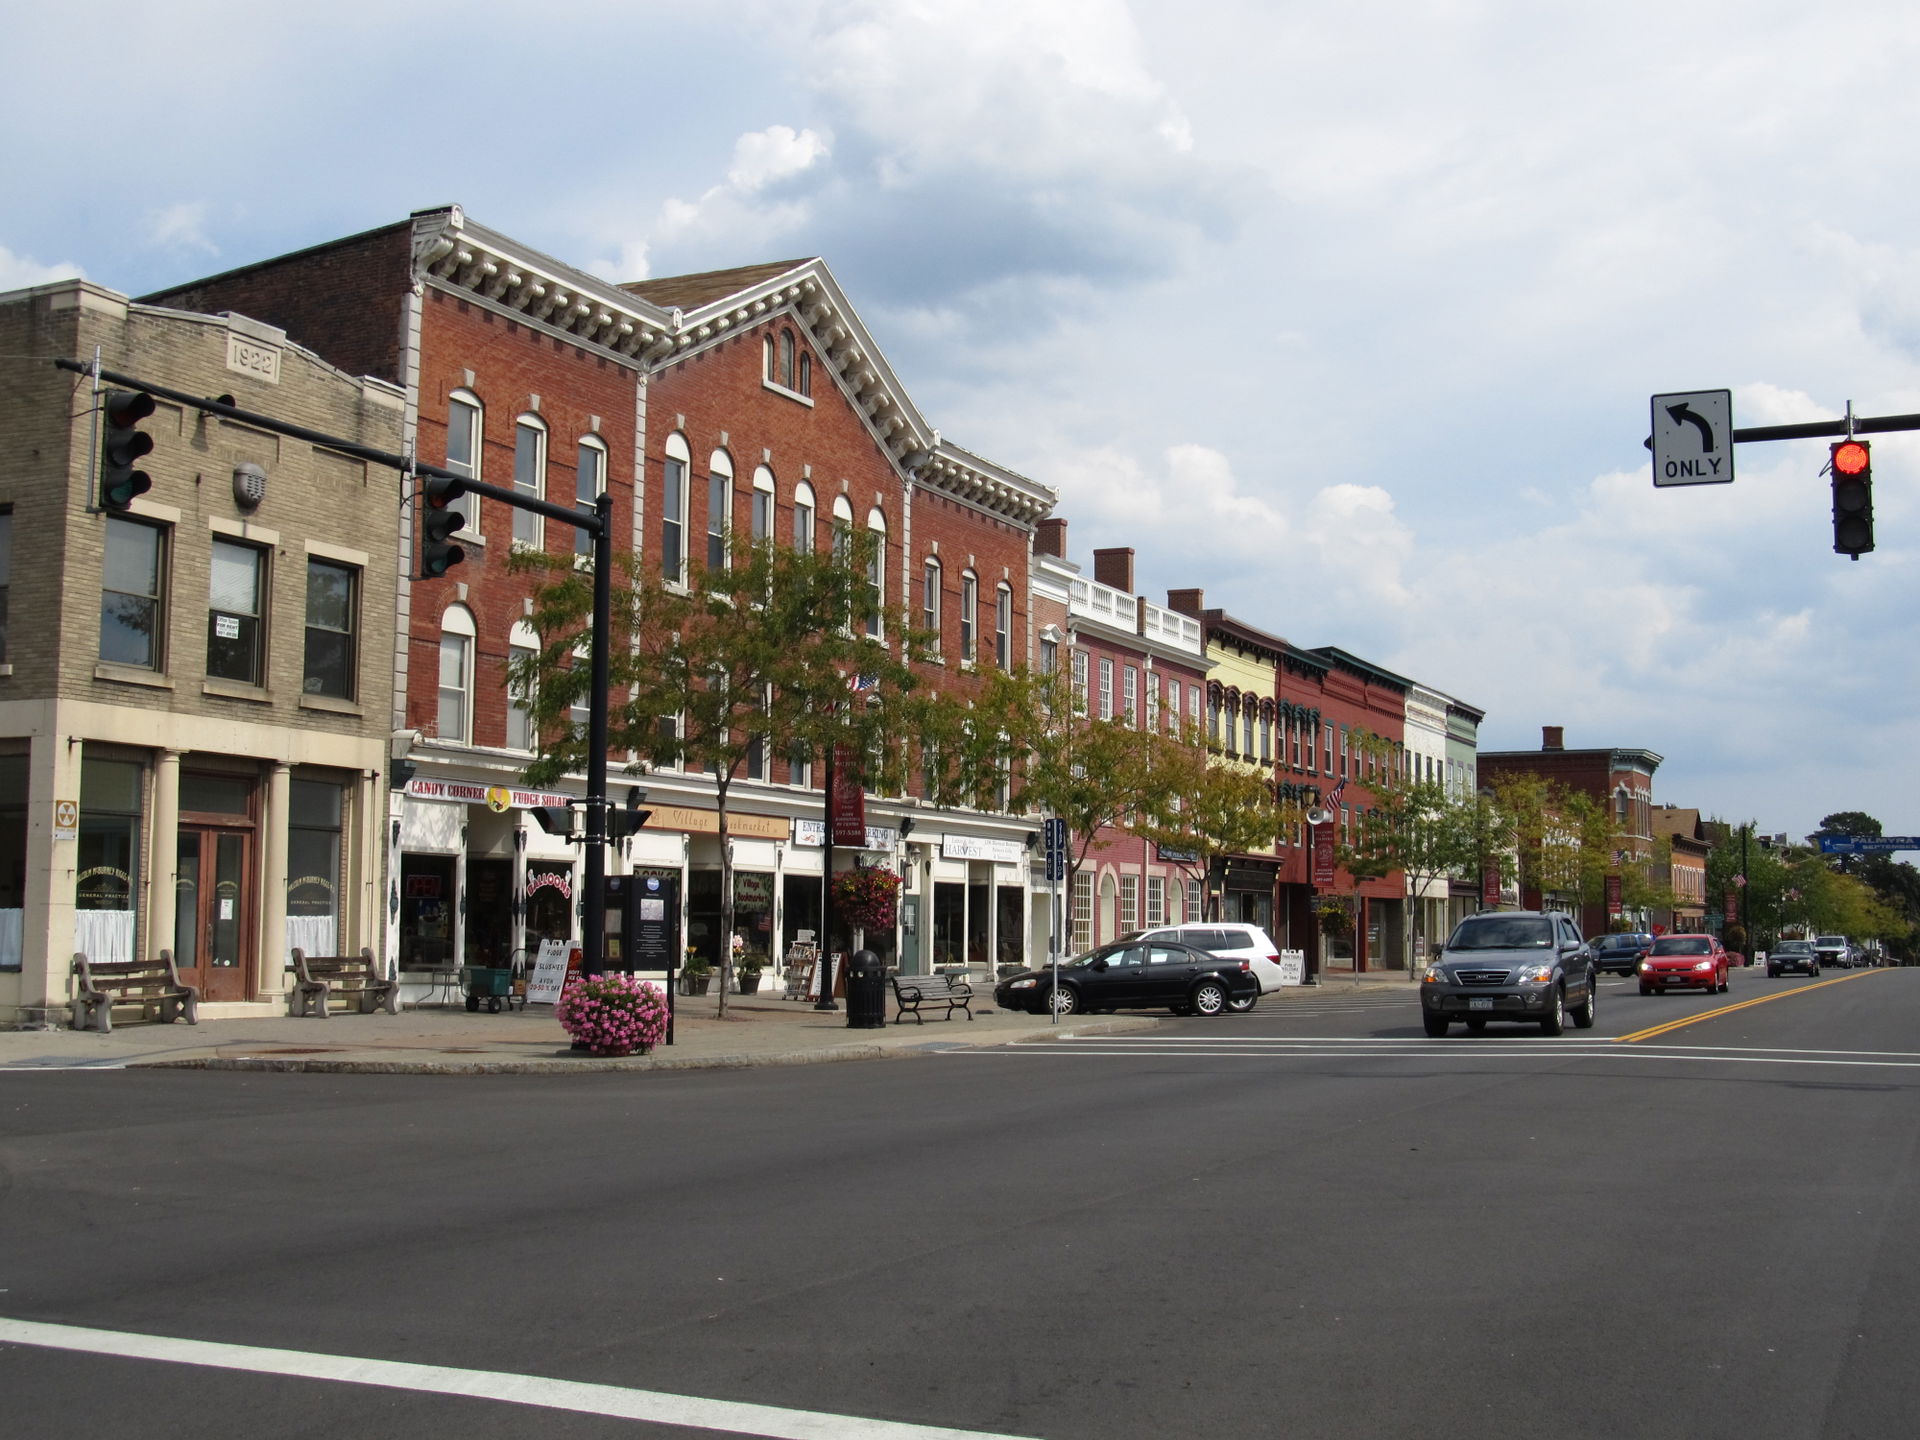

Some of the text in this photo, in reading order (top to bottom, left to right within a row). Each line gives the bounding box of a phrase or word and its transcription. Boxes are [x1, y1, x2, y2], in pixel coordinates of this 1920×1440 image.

[234, 345, 271, 374] 1922
[1665, 457, 1721, 478] ONLY
[411, 781, 445, 796] CANDY
[448, 785, 485, 799] CORNER
[513, 792, 540, 806] FUDGE
[673, 809, 708, 830] Village
[944, 844, 982, 857] HARVEST
[1850, 837, 1914, 845] PALMYRA
[527, 872, 571, 899] BALLOONS
[539, 963, 564, 971] SLUSHIES
